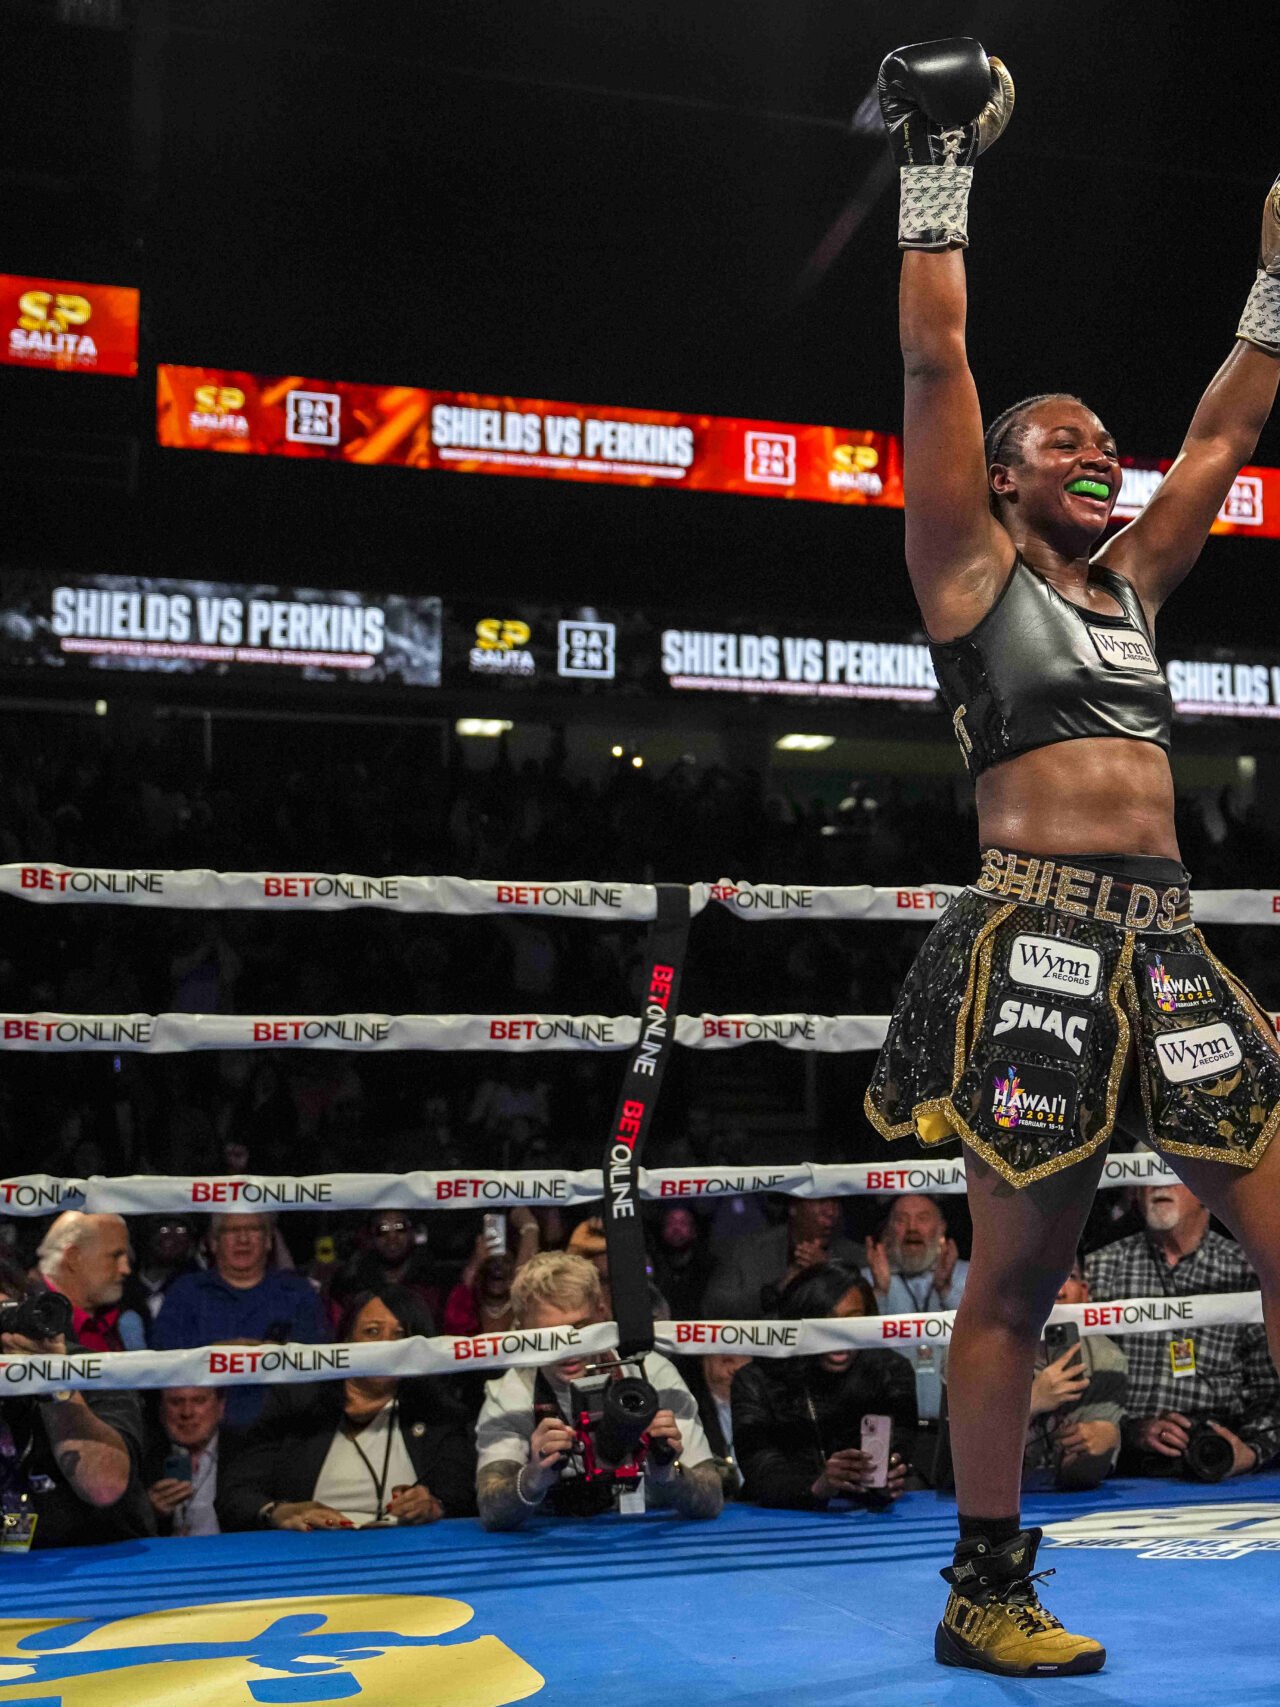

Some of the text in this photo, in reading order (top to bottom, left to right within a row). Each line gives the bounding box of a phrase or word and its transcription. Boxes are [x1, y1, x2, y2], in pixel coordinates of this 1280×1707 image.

[9, 328, 97, 357] SALITA
[432, 404, 541, 453] SHIELDS
[544, 416, 580, 457] VS
[585, 419, 693, 467] PERKINS
[52, 586, 191, 643] SHIELDS
[197, 597, 242, 646] VS
[247, 600, 385, 655] PERKINS
[1093, 632, 1150, 660] Wynn
[470, 647, 534, 670] SALITA
[662, 629, 778, 680] SHIELDS
[782, 636, 823, 683] VS
[826, 639, 938, 689] PERKINS
[1166, 660, 1270, 706] SHIELDS
[20, 868, 163, 894] BETONLINE
[263, 877, 399, 900] BETONLINE
[977, 849, 1181, 932] SHIELDS
[496, 885, 622, 909] BETONLINE
[1018, 943, 1092, 978] Wynn
[1052, 972, 1090, 986] RECORDS
[1179, 991, 1213, 1001] 2025
[3, 1019, 152, 1043] BETONLINE
[252, 1020, 390, 1042] BETONLINE
[489, 1020, 614, 1043] BETONLINE
[633, 963, 674, 1078] BETONLINE
[703, 1020, 816, 1040] BETONLINE
[992, 1000, 1089, 1057] SNAC
[1159, 1037, 1233, 1069] Wynn
[1199, 1050, 1235, 1066] RECORDS
[993, 1089, 1066, 1115] HAWAI'I
[1019, 1120, 1046, 1128] FEBRUARY
[1026, 1111, 1065, 1122] 2025
[611, 1099, 645, 1220] BETONLINE
[435, 1179, 567, 1200] BETONLINE
[866, 1167, 967, 1189] BETONLIN
[188, 1182, 333, 1203] BETONLINE
[1084, 1301, 1194, 1327] BETONLINE
[453, 1326, 582, 1360] BETONLINE
[675, 1324, 798, 1346] BETONLINE
[208, 1349, 350, 1374] BETONLINE
[1062, 1538, 1140, 1546] BIG
[1144, 1538, 1233, 1548] TIME
[1154, 1549, 1238, 1558] USA
